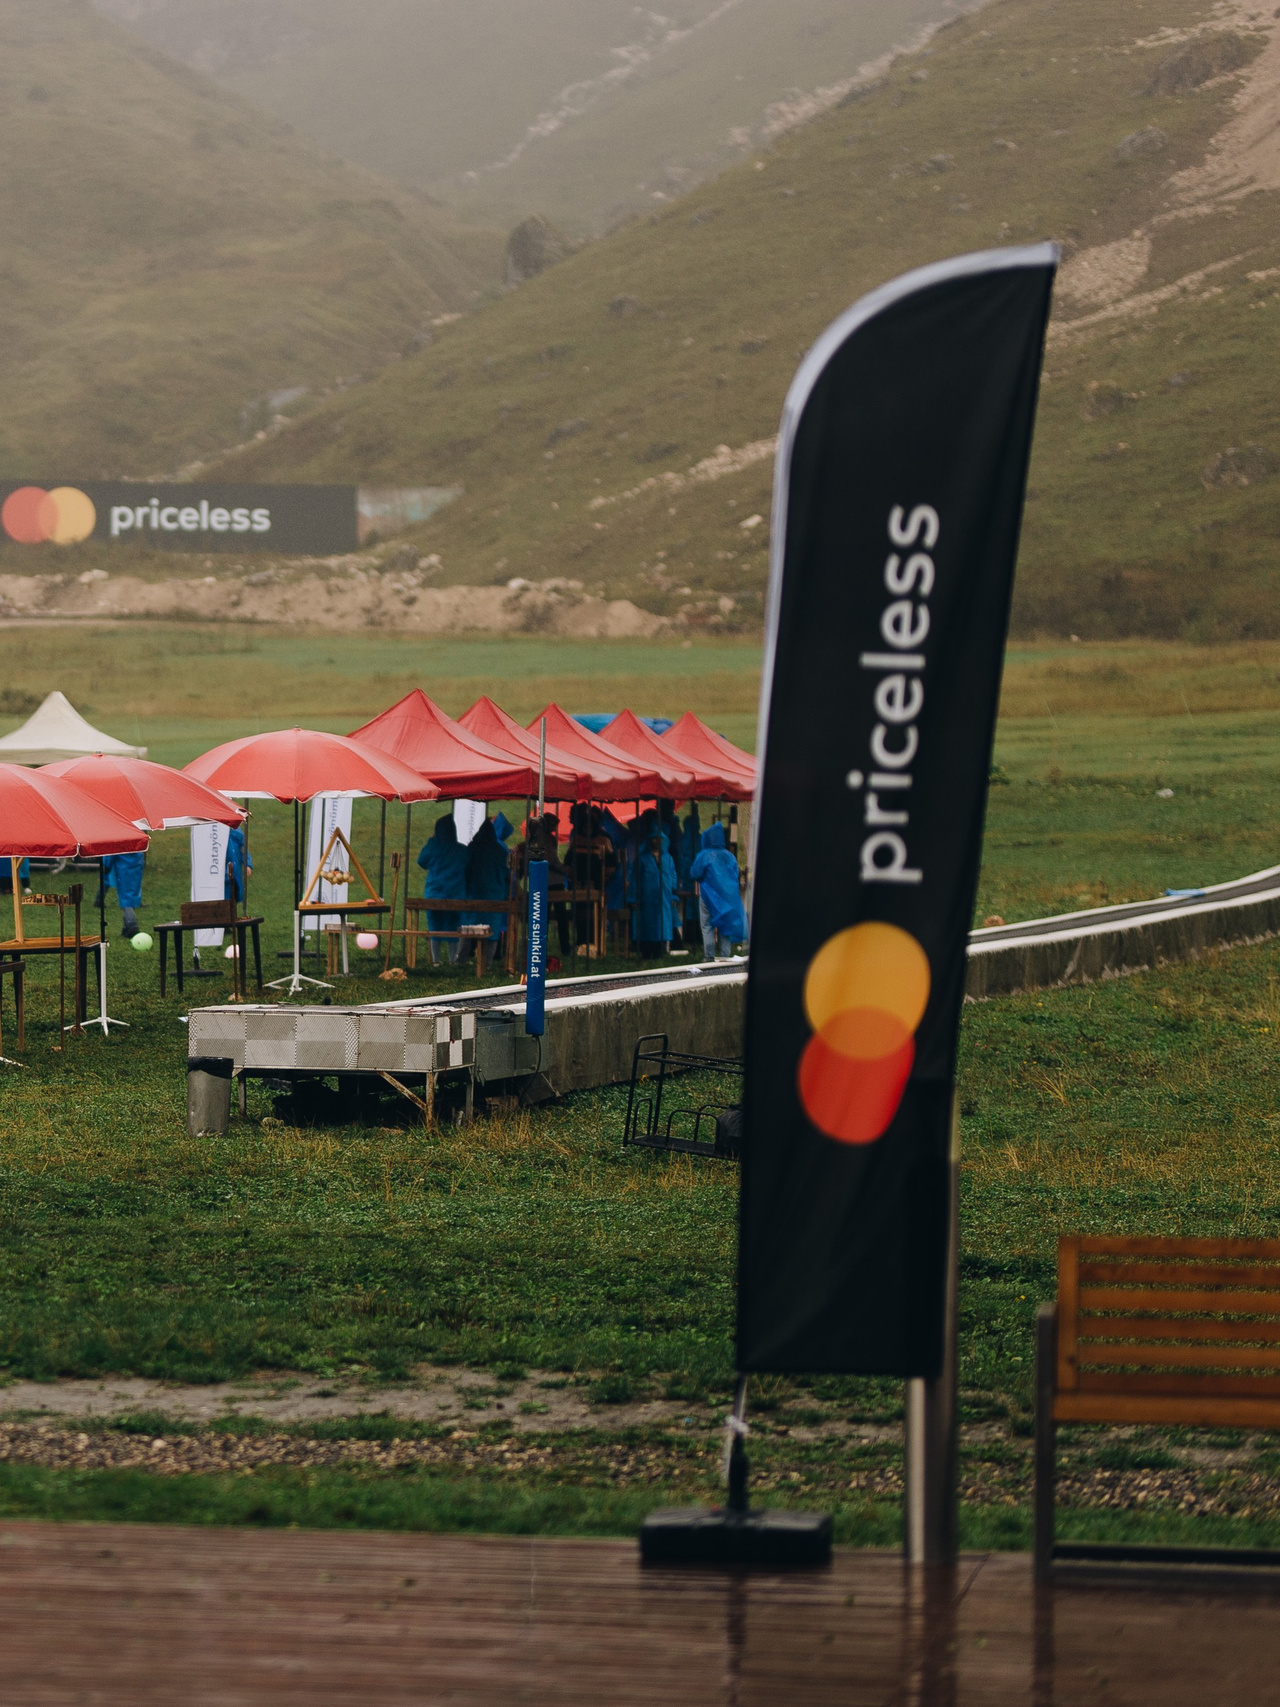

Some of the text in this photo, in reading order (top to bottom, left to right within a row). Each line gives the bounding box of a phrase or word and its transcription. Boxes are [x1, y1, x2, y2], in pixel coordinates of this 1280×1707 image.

[110, 497, 271, 536] priceless
[846, 503, 941, 884] priceless
[209, 824, 222, 875] Datayön
[530, 891, 542, 978] www.sunkid.at
